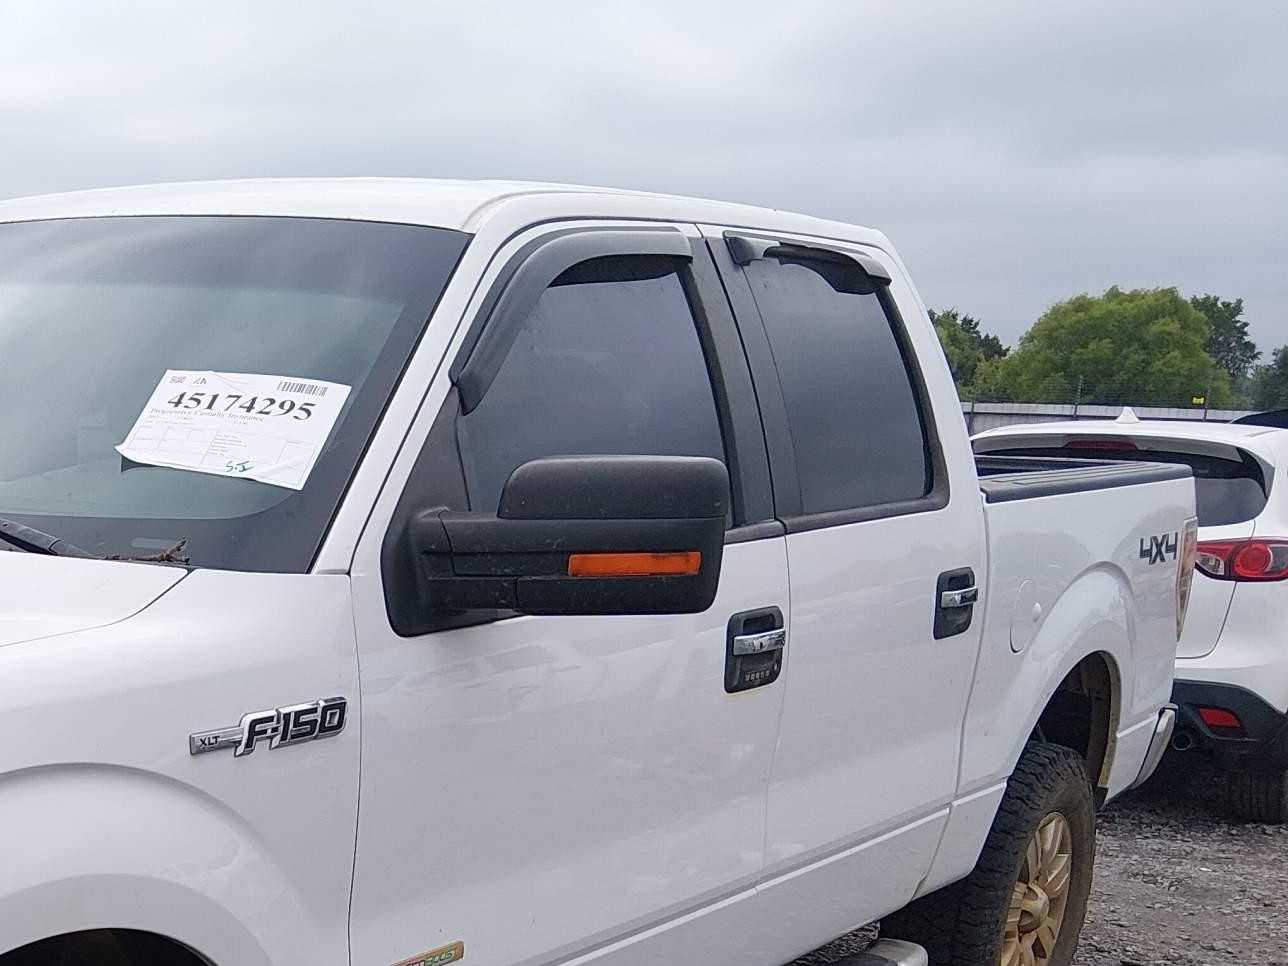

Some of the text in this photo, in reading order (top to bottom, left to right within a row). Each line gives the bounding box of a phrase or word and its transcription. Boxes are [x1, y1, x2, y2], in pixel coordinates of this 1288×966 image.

[167, 391, 317, 421] 45174295
[199, 697, 347, 757] XLT F-150
